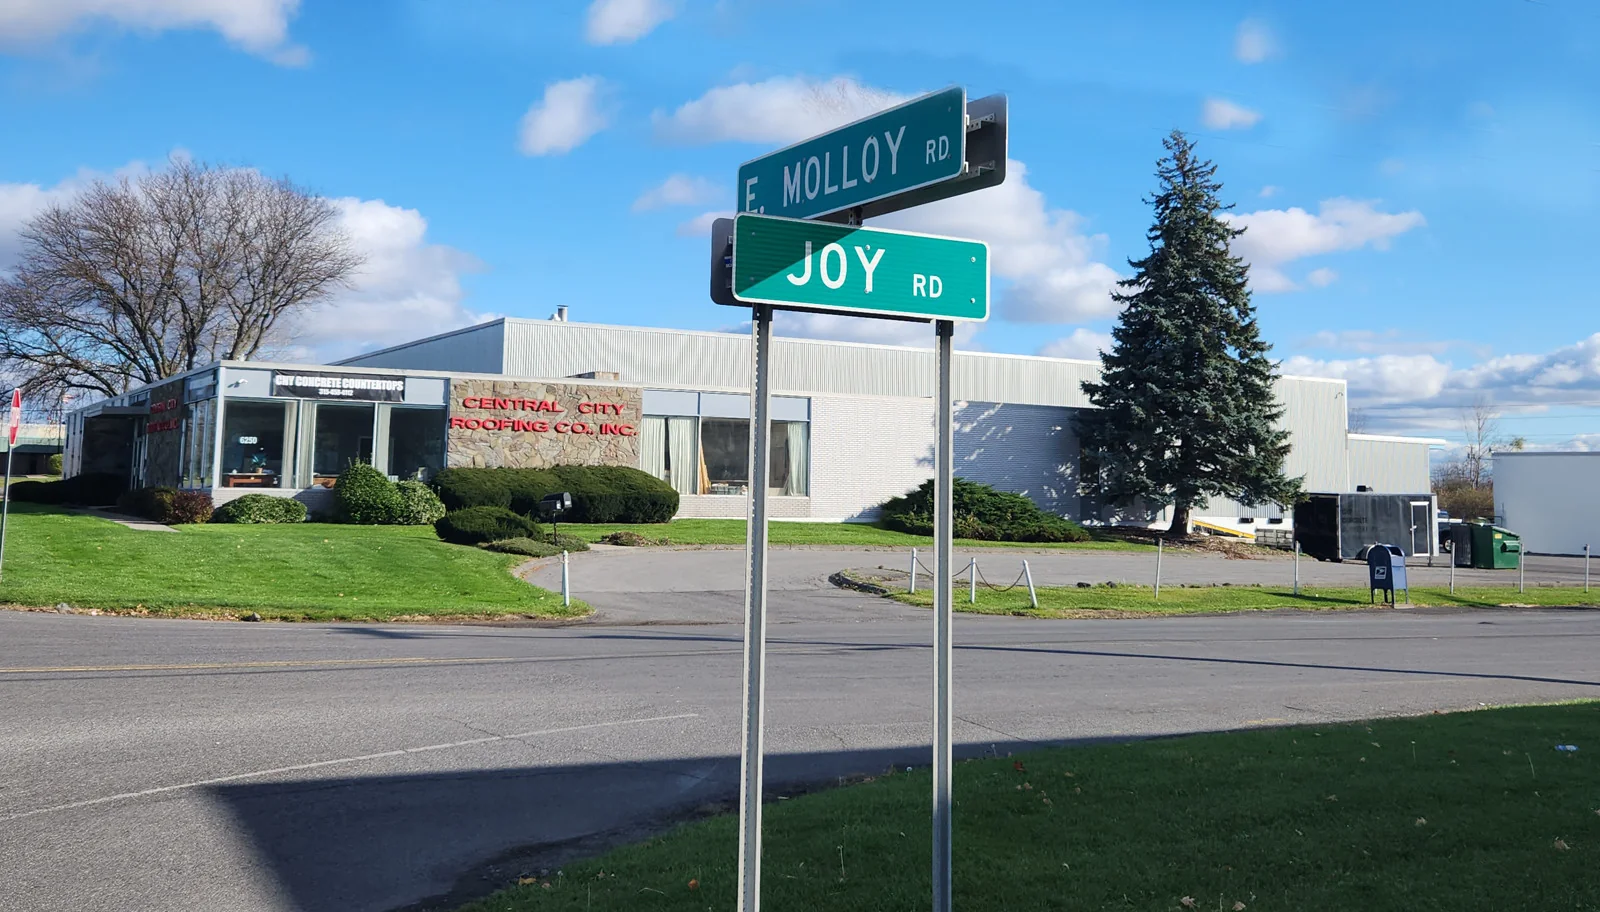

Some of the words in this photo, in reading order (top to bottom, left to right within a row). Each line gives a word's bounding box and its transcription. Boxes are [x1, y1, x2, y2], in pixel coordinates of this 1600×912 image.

[745, 176, 765, 213] E.
[783, 125, 906, 207] MOLLOY
[925, 135, 950, 165] RD
[786, 240, 886, 293] JOY
[912, 273, 943, 299] RD
[295, 376, 342, 388] CONCRETE
[342, 378, 404, 390] COUNTERTOPS
[463, 396, 564, 413] CENTRAL
[578, 401, 626, 415] CITY
[450, 416, 549, 433] ROOFING
[600, 423, 639, 437] INC.
[240, 436, 258, 444] 6250
